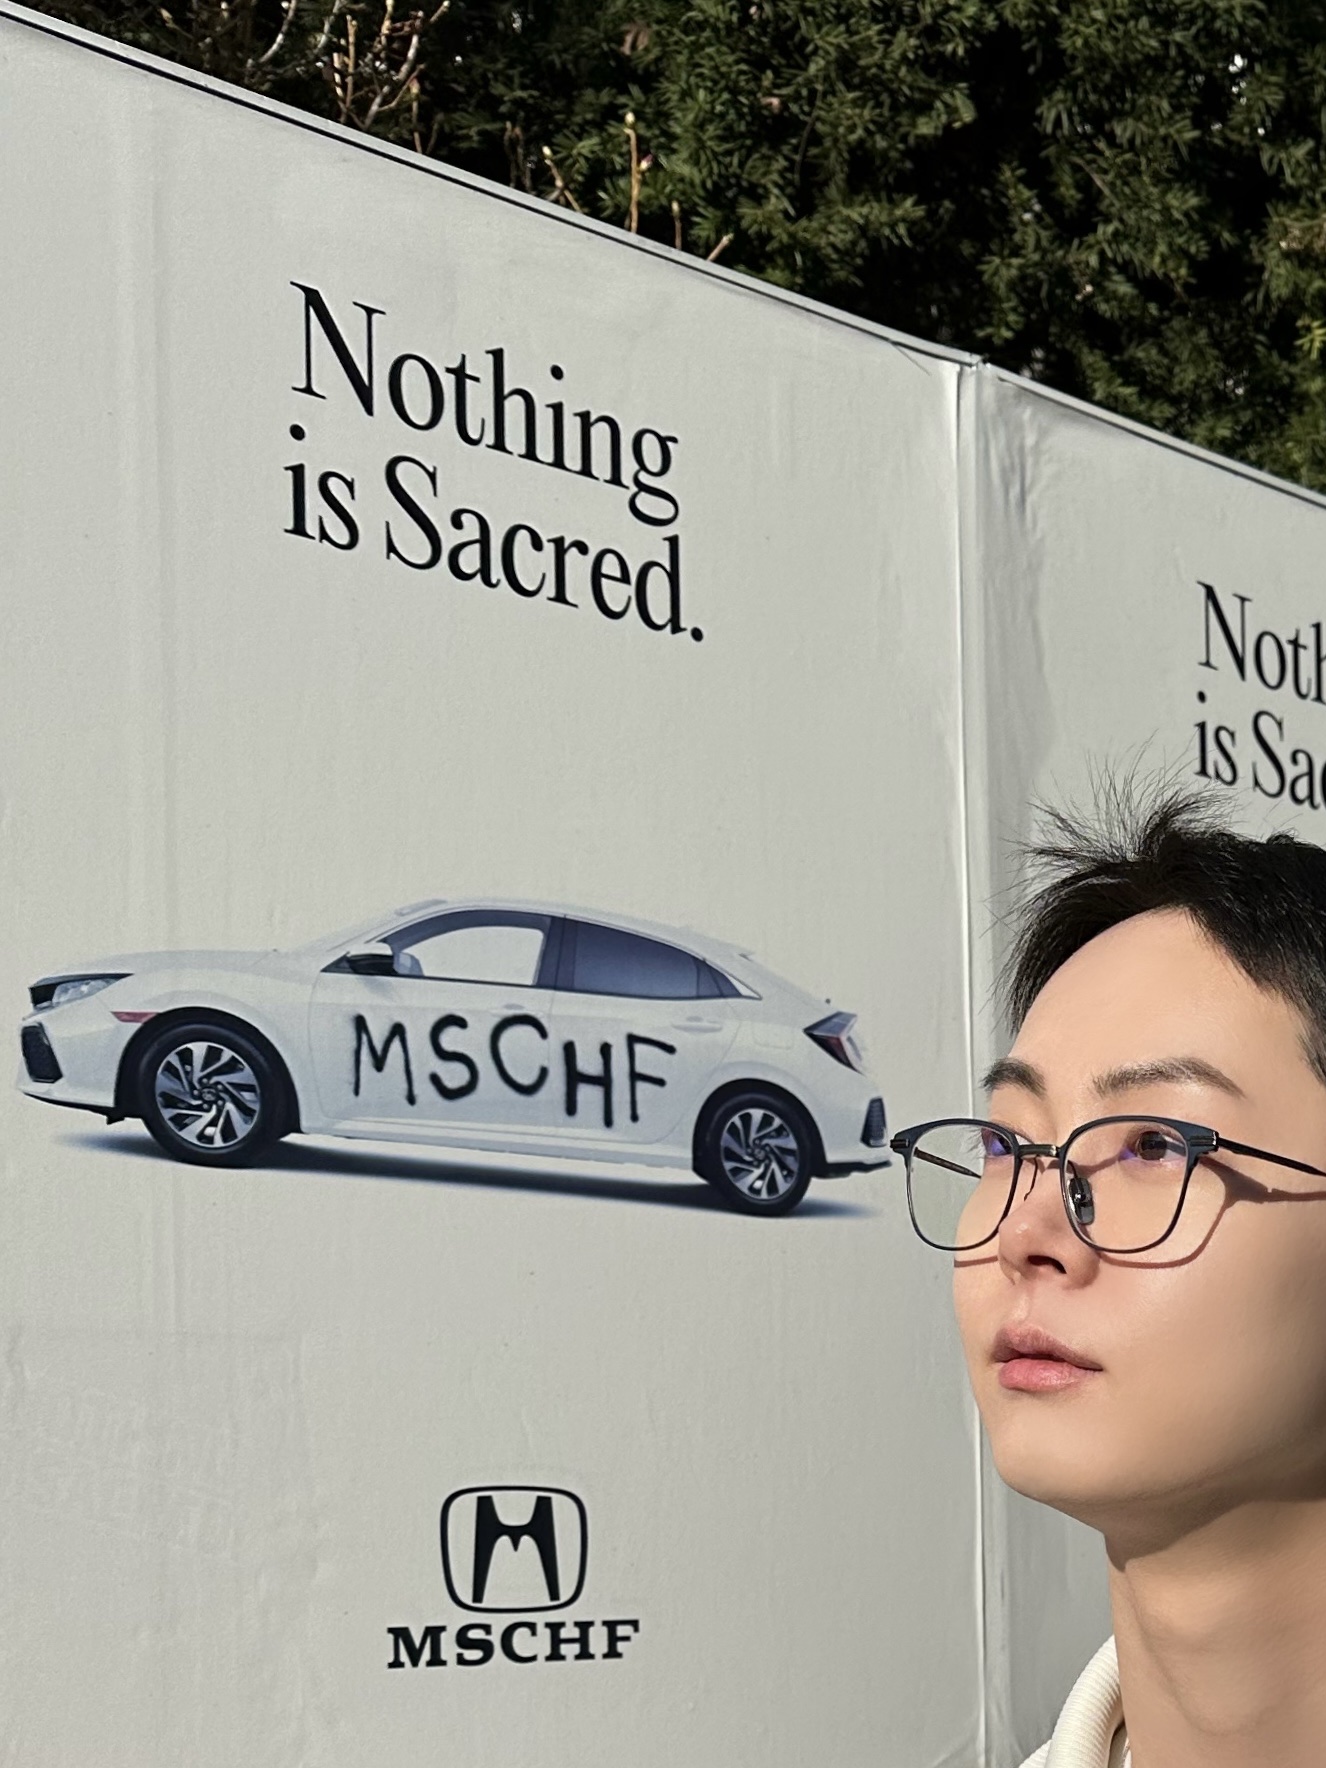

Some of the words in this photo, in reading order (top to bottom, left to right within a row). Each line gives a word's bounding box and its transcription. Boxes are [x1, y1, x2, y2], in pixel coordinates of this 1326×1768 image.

[290, 281, 679, 526] Nothing
[283, 424, 359, 551] is
[385, 455, 704, 642] Sacred.
[1194, 690, 1238, 787] is
[354, 1014, 677, 1128] MSCHF
[387, 1619, 640, 1669] MSCHF
